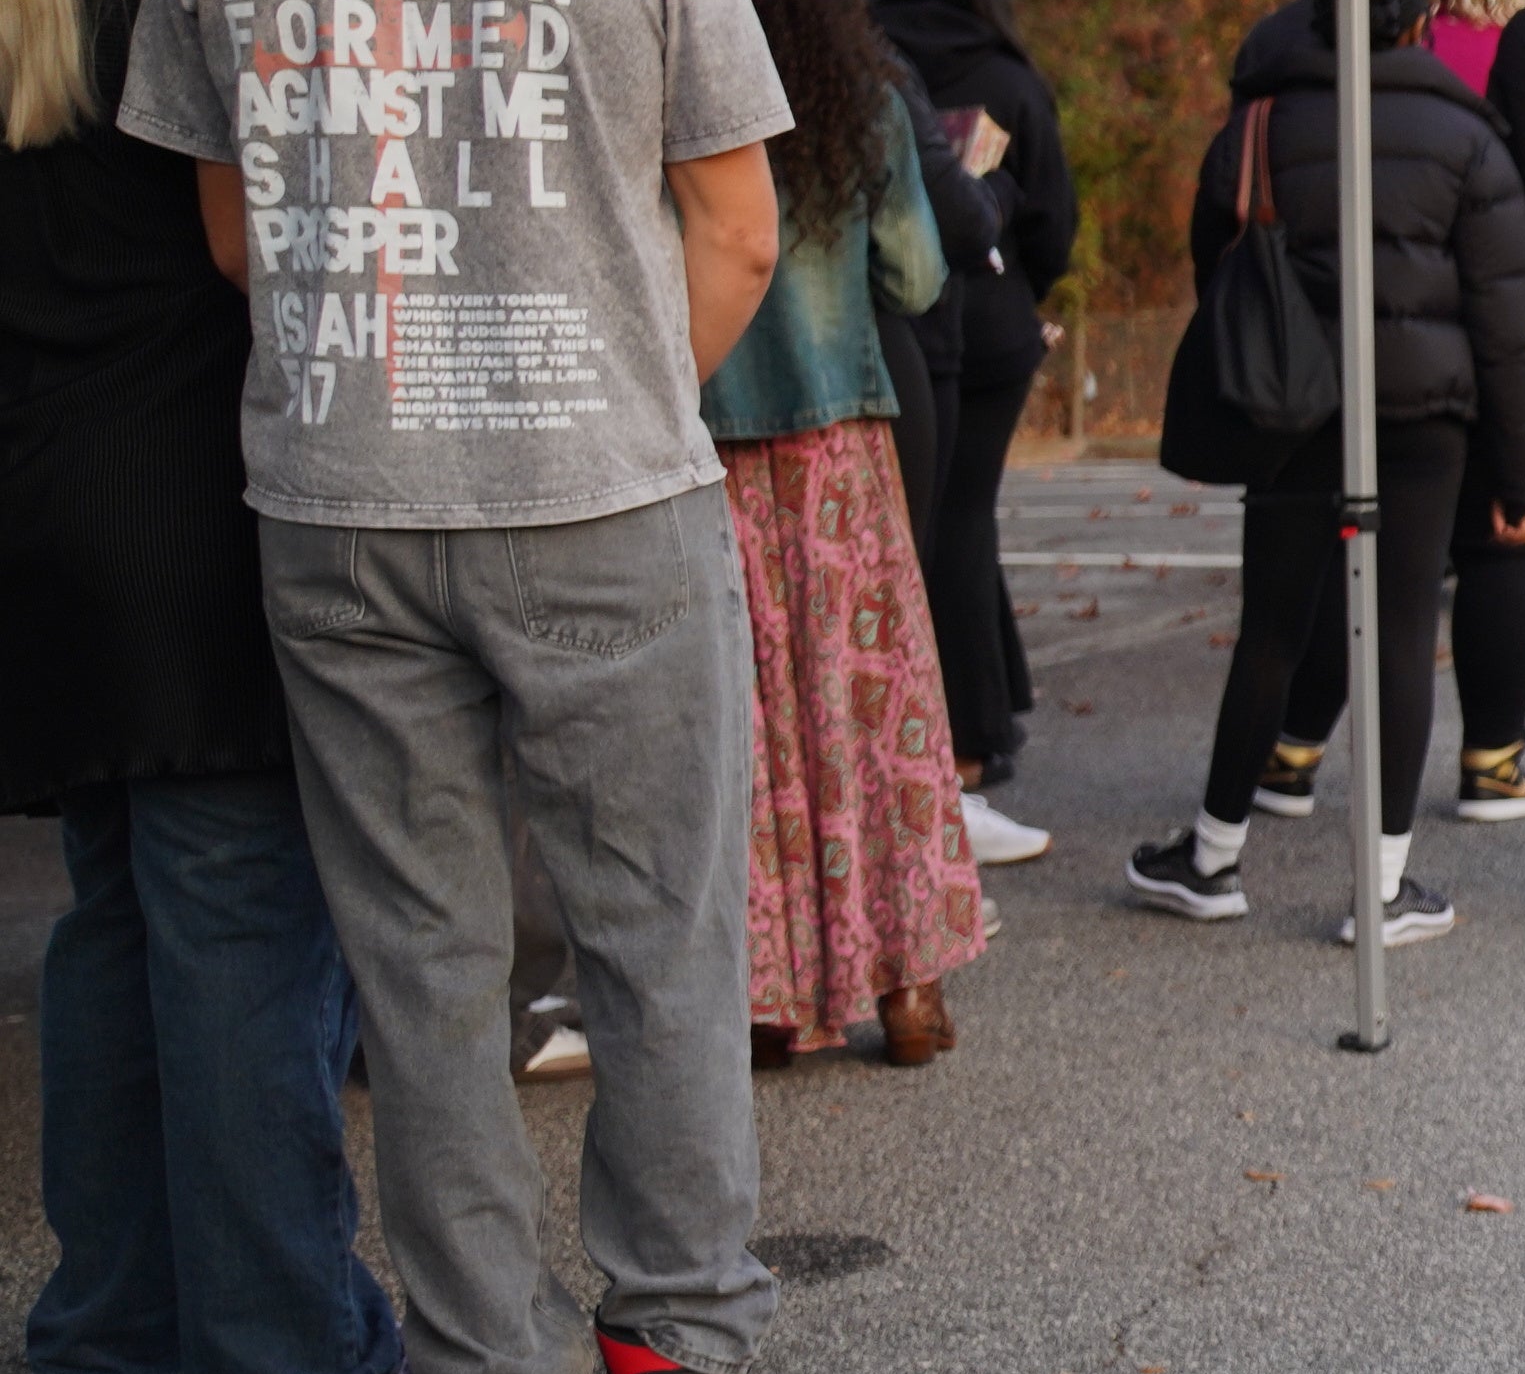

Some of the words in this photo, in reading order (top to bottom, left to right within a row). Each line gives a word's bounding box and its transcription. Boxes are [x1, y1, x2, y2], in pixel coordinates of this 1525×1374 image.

[238, 67, 456, 139] AGAINST
[482, 70, 570, 141] ME
[242, 137, 567, 208] SHALL
[252, 206, 460, 275] PROSPER
[392, 293, 436, 308] AND
[438, 293, 494, 308] EVERY
[499, 292, 568, 307] TONGUE
[392, 308, 456, 323] WHICH
[459, 308, 506, 323] RISES
[510, 307, 589, 322] AGAINST
[392, 324, 433, 338] YOU
[436, 324, 454, 338] IN
[457, 324, 549, 338] JUDGMENT
[552, 323, 586, 338] YOU
[392, 339, 456, 353] SHALL
[550, 338, 588, 352] THIS
[590, 338, 605, 352] IS
[392, 355, 429, 369] THE
[431, 355, 514, 369] HERITAGE
[516, 354, 542, 368] OF
[546, 353, 578, 368] THE
[392, 371, 490, 385] SERVANTS
[492, 371, 514, 384] OF
[516, 370, 552, 384] THE
[392, 386, 436, 400] AND
[438, 386, 488, 400] THEIR
[542, 400, 561, 414] IS
[564, 398, 608, 413] FROM
[434, 416, 484, 430] SAYS
[486, 416, 519, 430] THE
